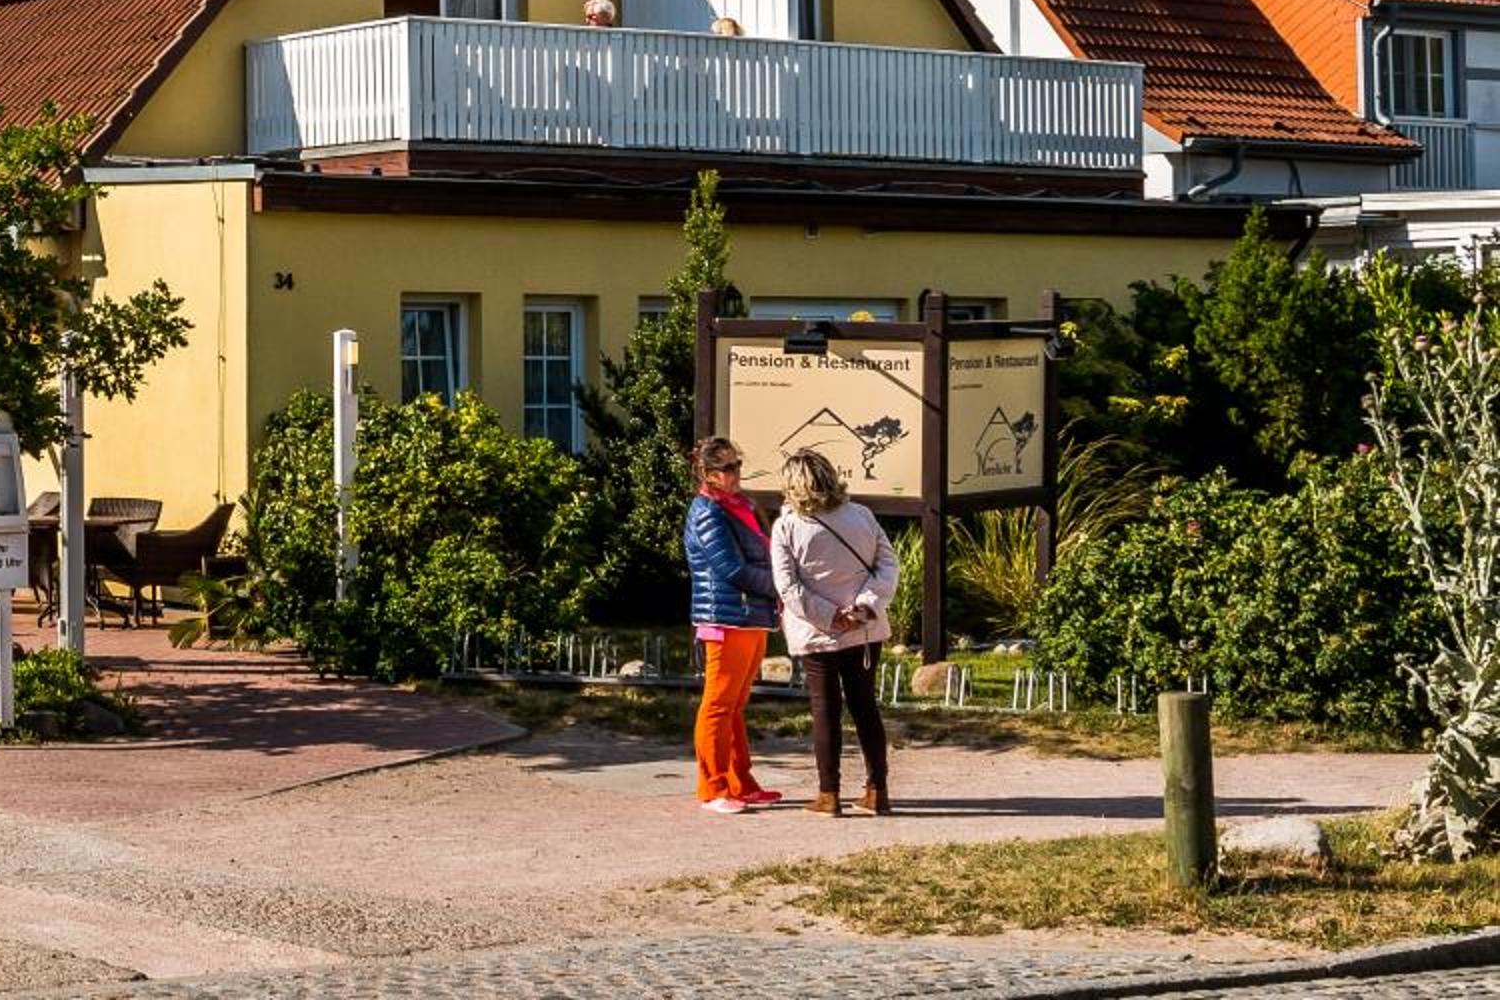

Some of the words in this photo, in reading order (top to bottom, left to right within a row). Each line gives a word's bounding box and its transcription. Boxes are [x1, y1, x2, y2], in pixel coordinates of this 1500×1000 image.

[273, 271, 295, 291] 34
[727, 352, 795, 369] Pension
[800, 354, 812, 369] &
[817, 355, 911, 371] Restaurant
[949, 356, 983, 369] Pension
[985, 355, 993, 368] &
[994, 353, 1039, 368] Restaurant
[5, 557, 23, 568] Uhr
